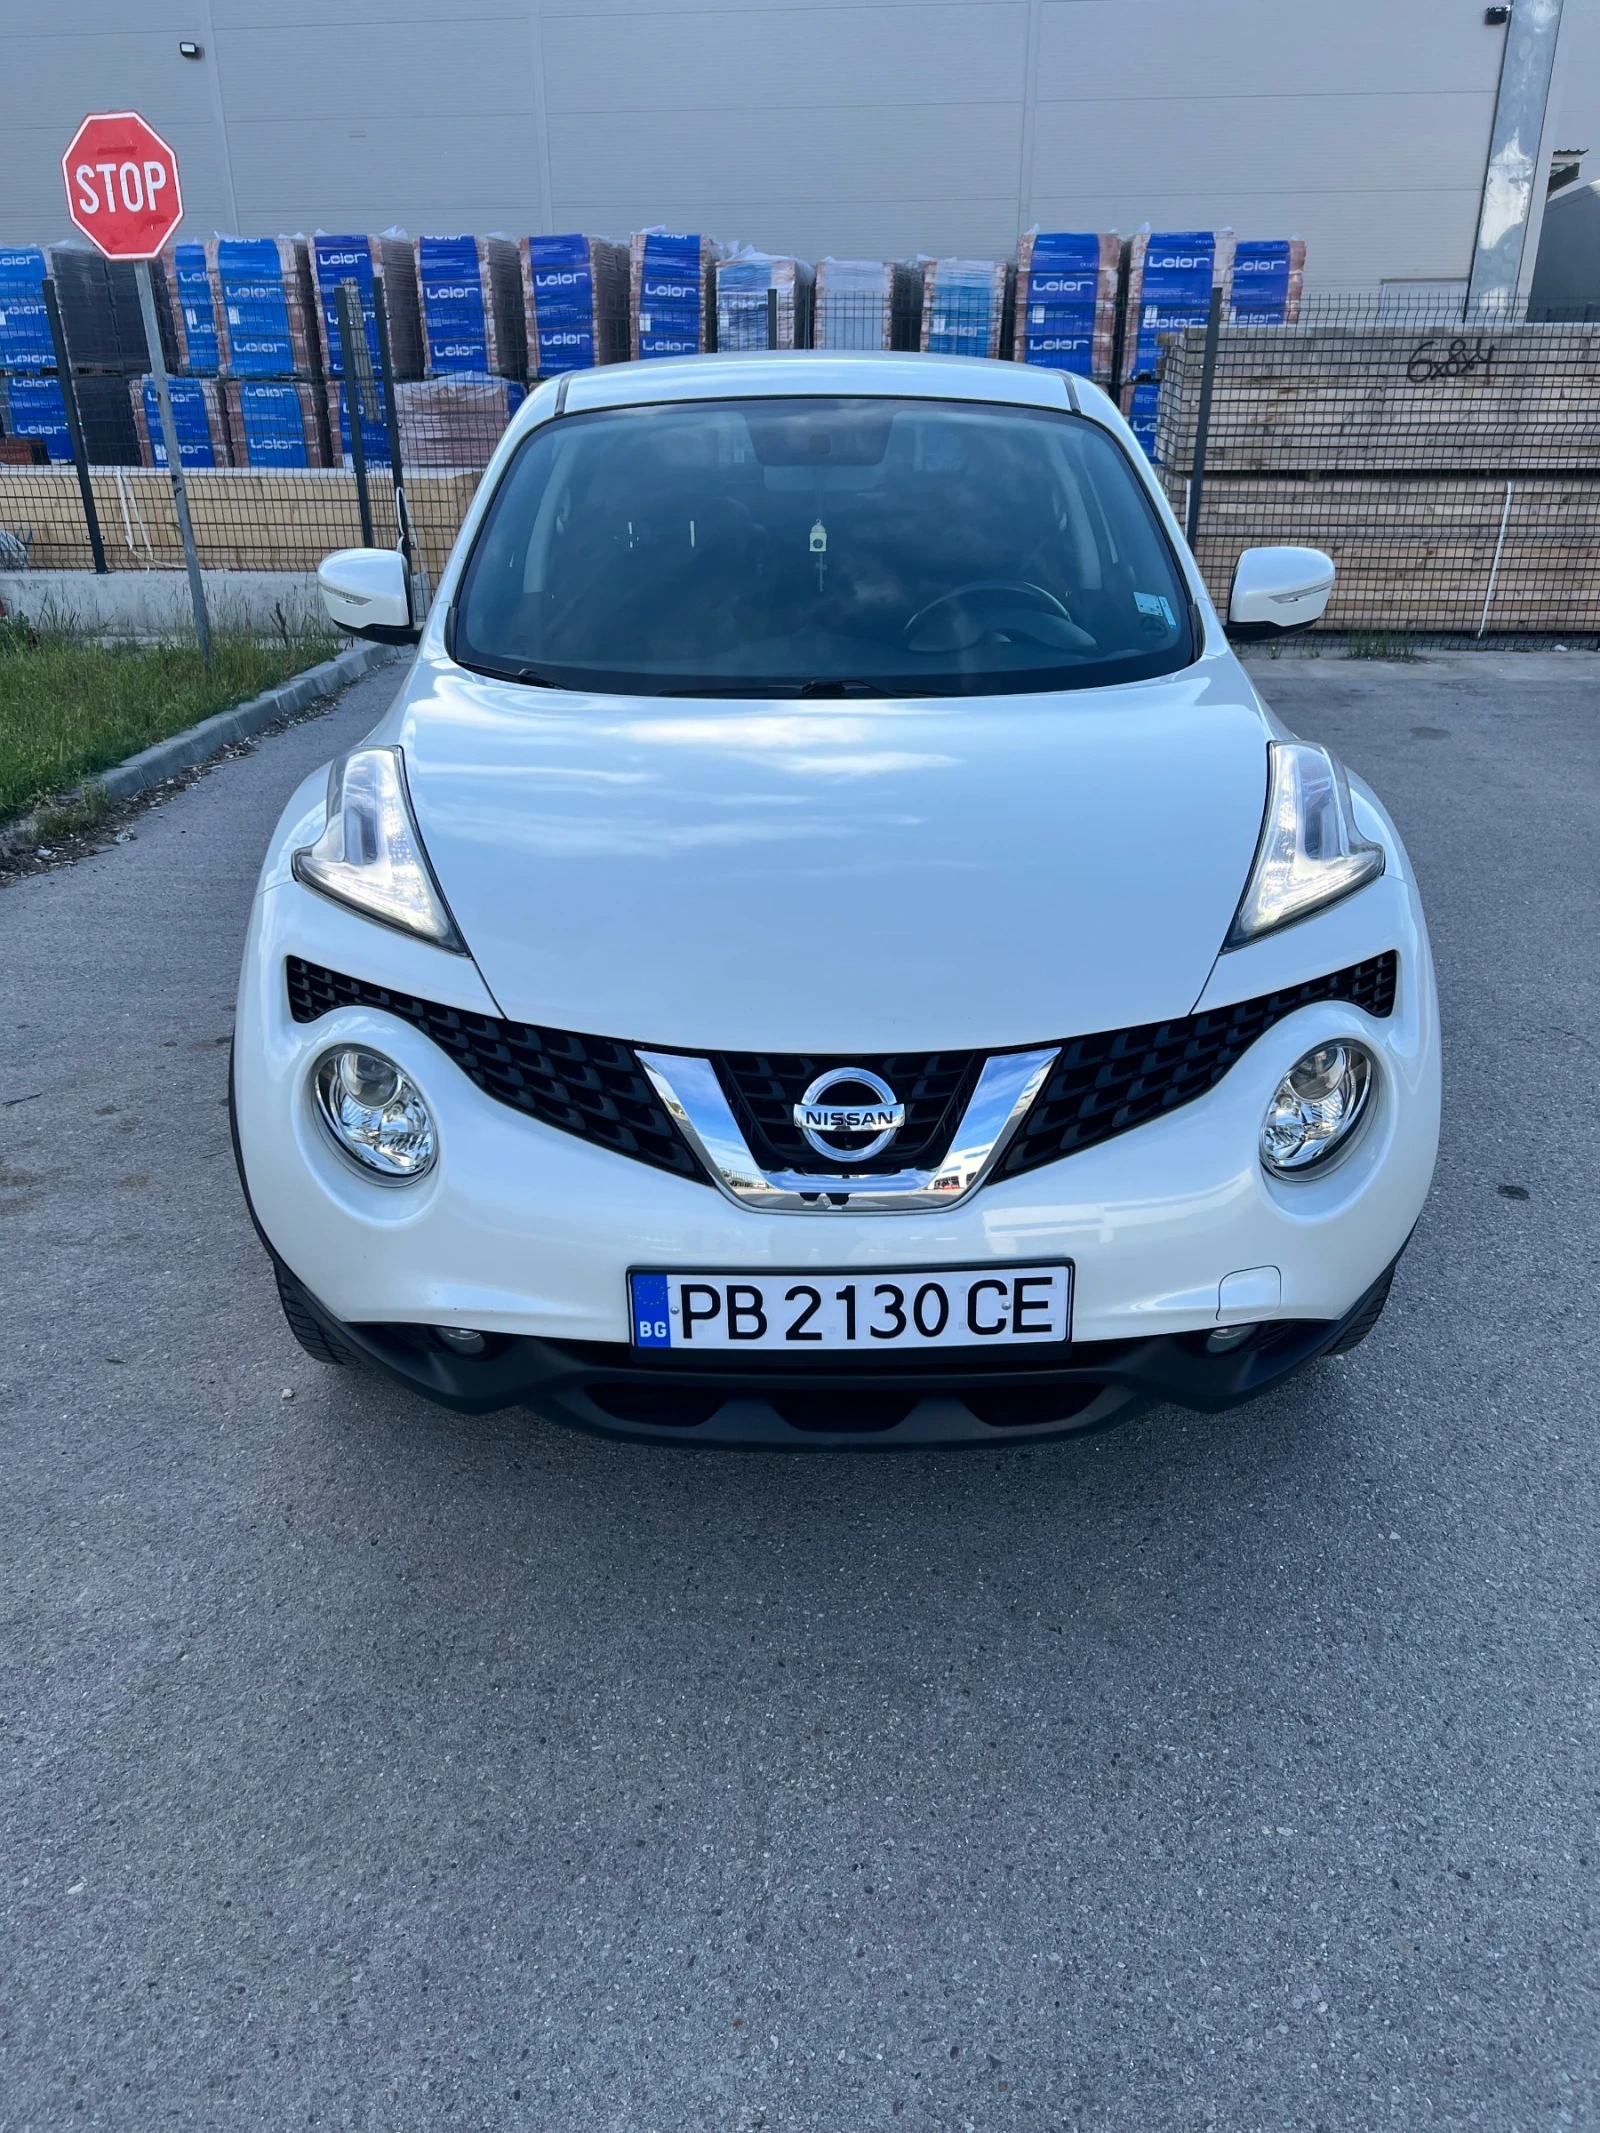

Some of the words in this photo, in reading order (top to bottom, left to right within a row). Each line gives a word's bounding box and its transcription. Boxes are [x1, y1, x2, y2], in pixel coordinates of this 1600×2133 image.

[76, 161, 166, 214] STOP
[0, 255, 40, 266] eier
[319, 253, 367, 265] Leier
[1148, 255, 1210, 268] Leier
[536, 273, 588, 286] Leier
[1032, 279, 1094, 292] Leier
[427, 286, 479, 299] Leier
[645, 283, 696, 297] Leier
[1236, 313, 1280, 324] eier
[541, 332, 589, 345] Leier
[1028, 338, 1089, 350] Leier
[434, 343, 483, 357] Leier
[642, 340, 695, 351] Leier
[147, 391, 199, 402] Lier
[806, 1111, 893, 1126] NISSAN
[639, 1320, 667, 1338] BG
[680, 1284, 768, 1341] PB
[784, 1281, 950, 1342] 2130
[966, 1276, 1054, 1335] CE
